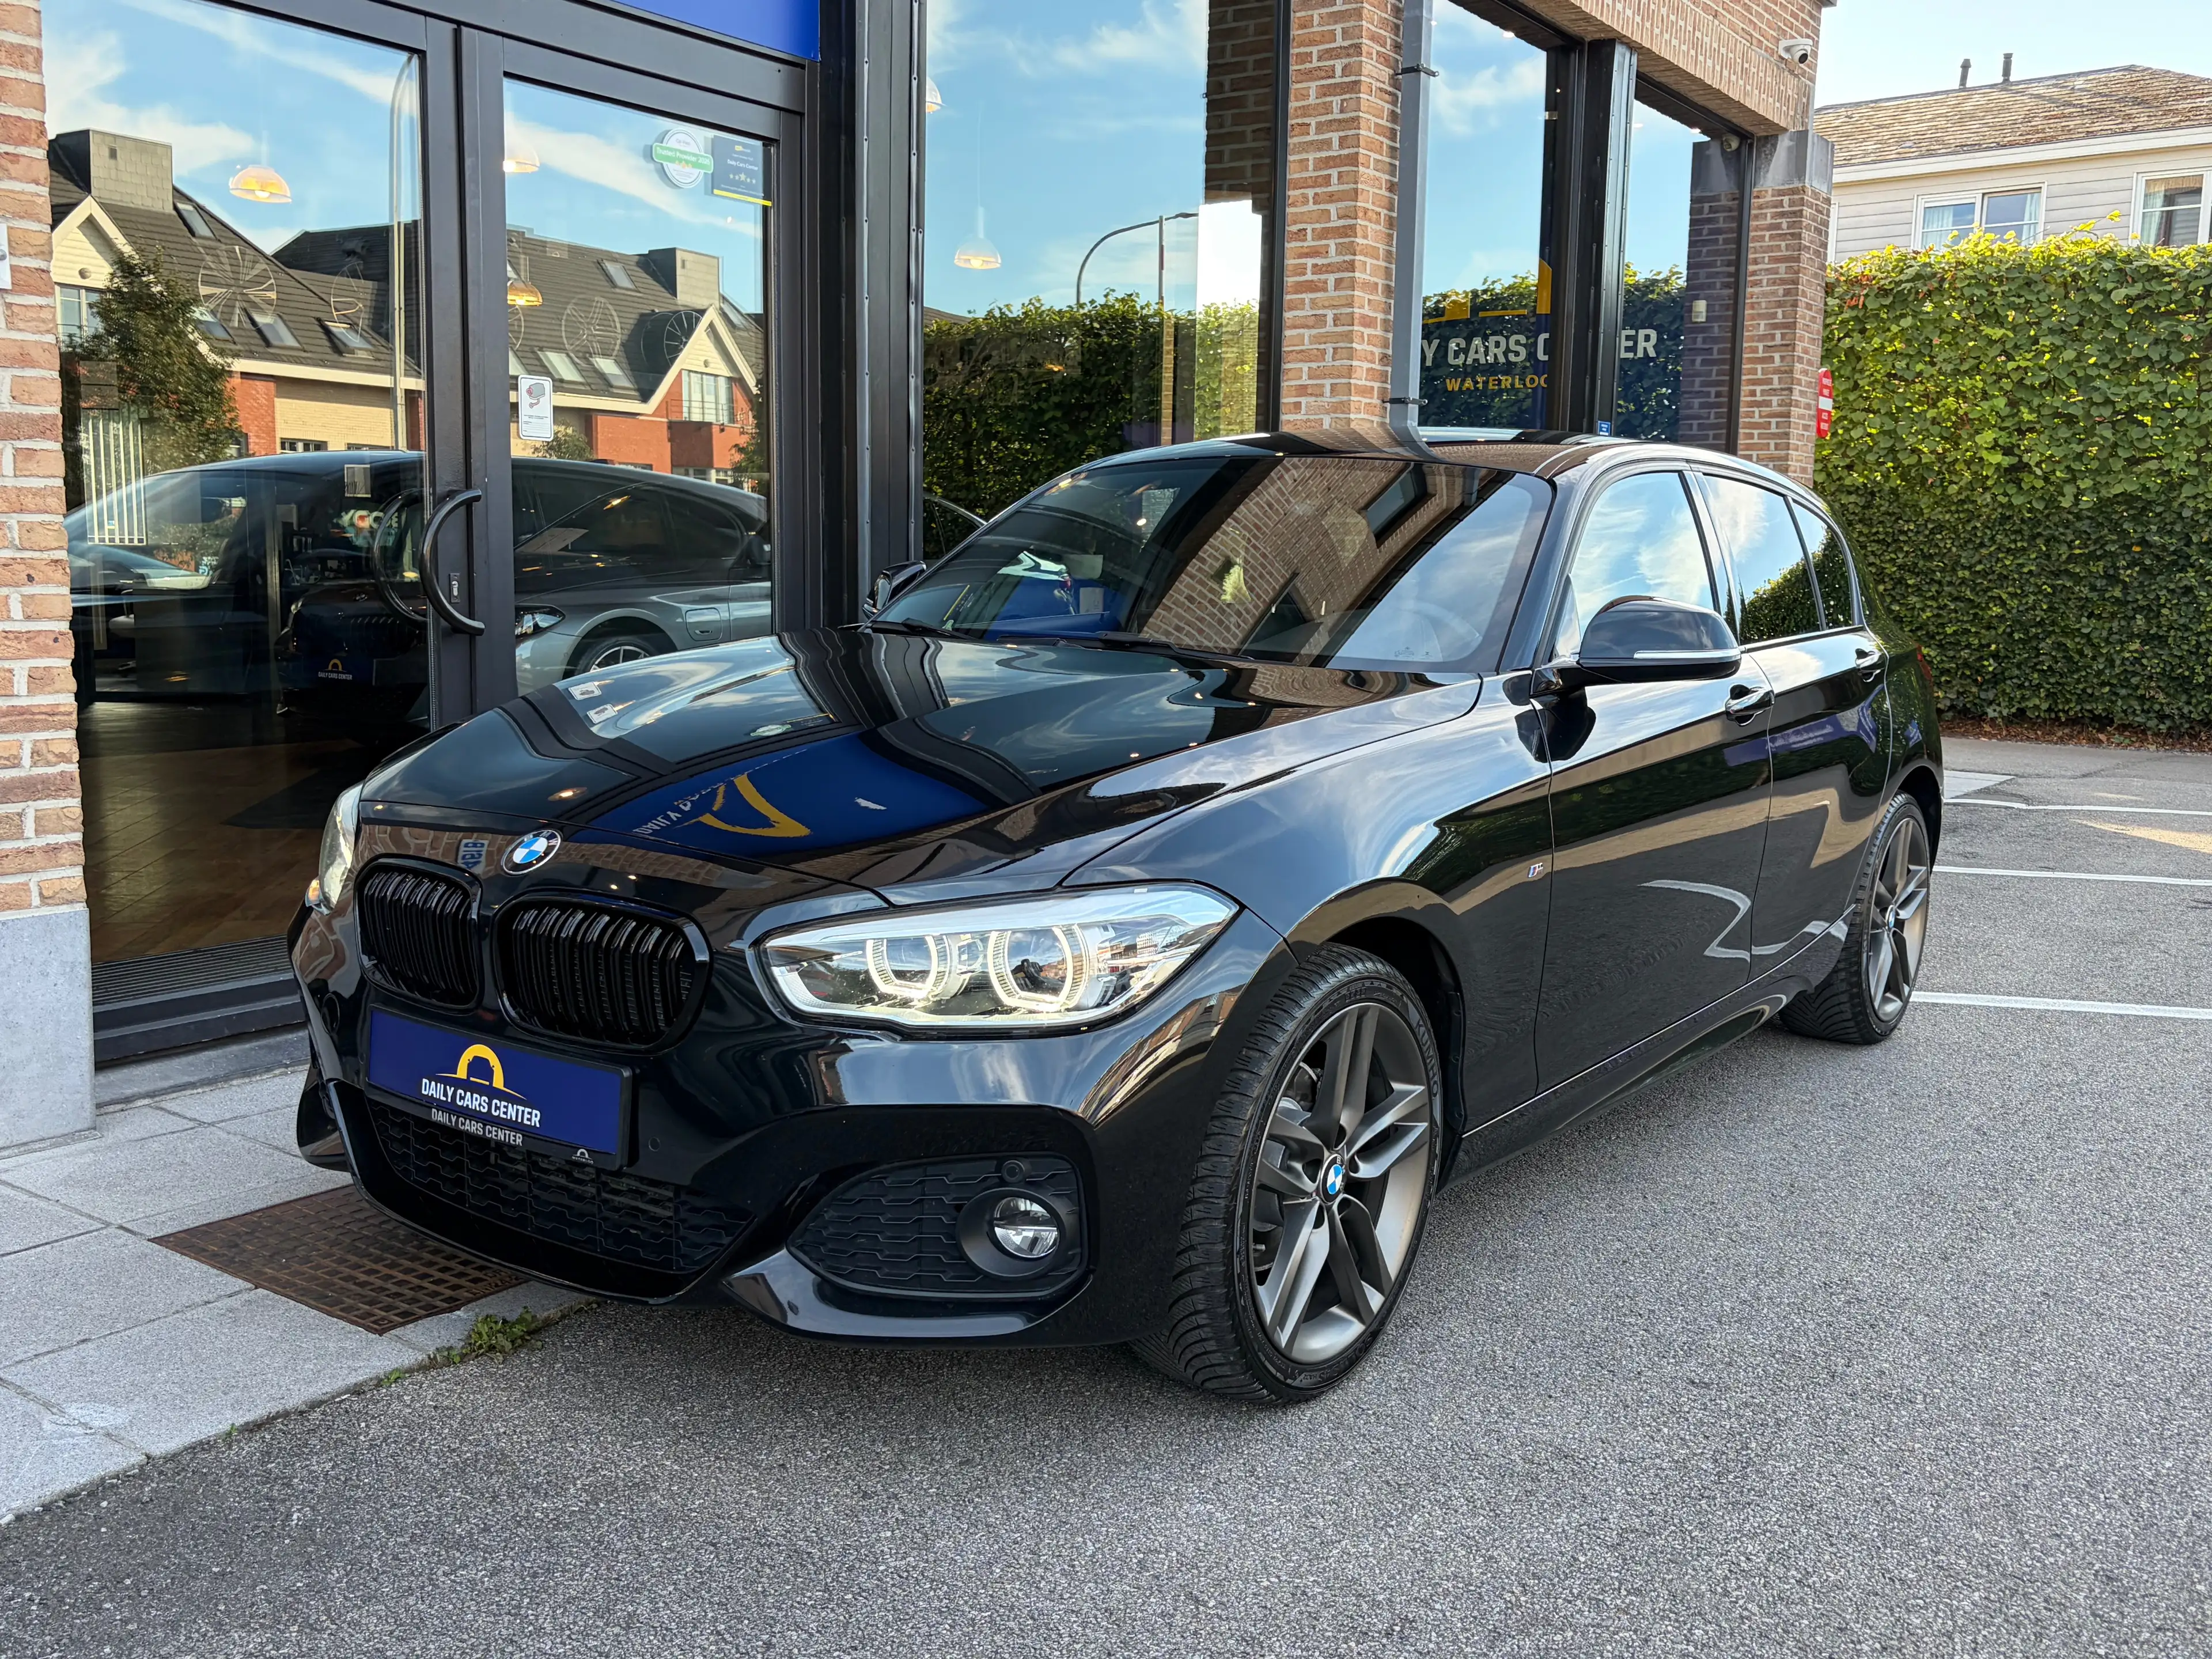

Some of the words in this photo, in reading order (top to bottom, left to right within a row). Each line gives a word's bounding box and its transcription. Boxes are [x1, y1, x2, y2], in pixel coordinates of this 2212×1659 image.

[656, 146, 675, 157] Trusted
[676, 151, 697, 162] Provider
[1448, 334, 1527, 365] CARS
[1415, 1017, 1439, 1098] KUMHO
[421, 1078, 454, 1103] DAILY
[456, 1089, 488, 1113] CARS
[491, 1099, 541, 1128] CENTER
[431, 1108, 457, 1127] DAILY
[459, 1117, 483, 1135] CARS
[485, 1125, 523, 1146] CENTER
